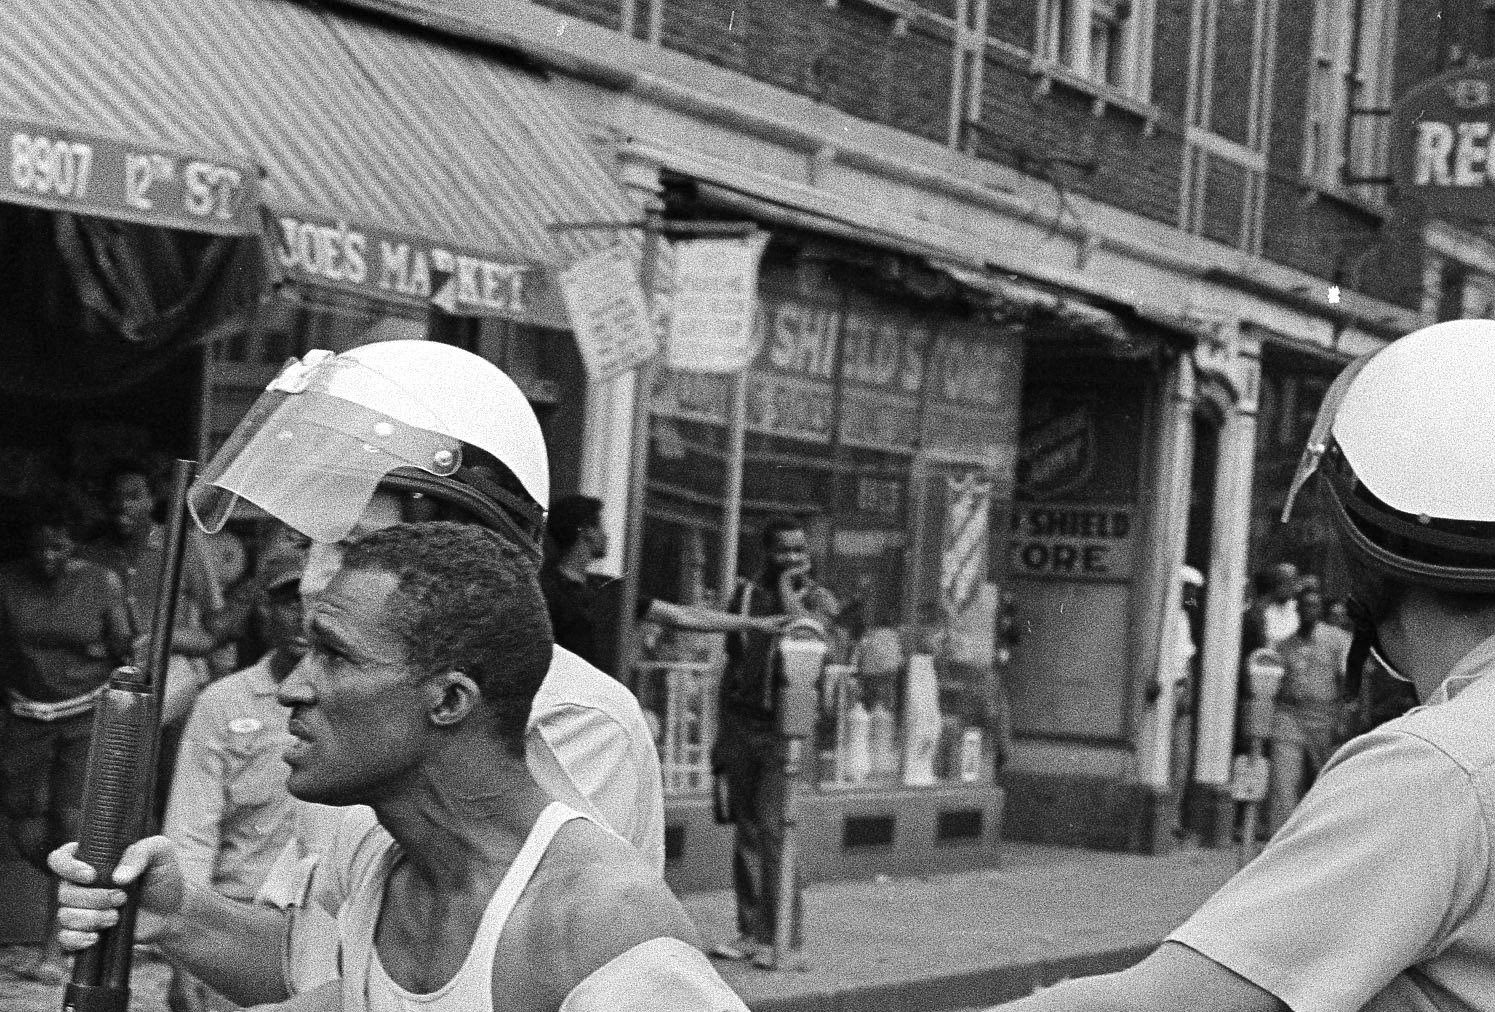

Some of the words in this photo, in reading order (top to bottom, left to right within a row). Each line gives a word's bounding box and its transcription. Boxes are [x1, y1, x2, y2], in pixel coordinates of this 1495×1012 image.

[10, 132, 92, 199] 8907
[185, 161, 241, 221] ST
[1415, 121, 1495, 187] RE
[277, 218, 367, 284] JOE'S
[1028, 510, 1131, 538] SHIELD
